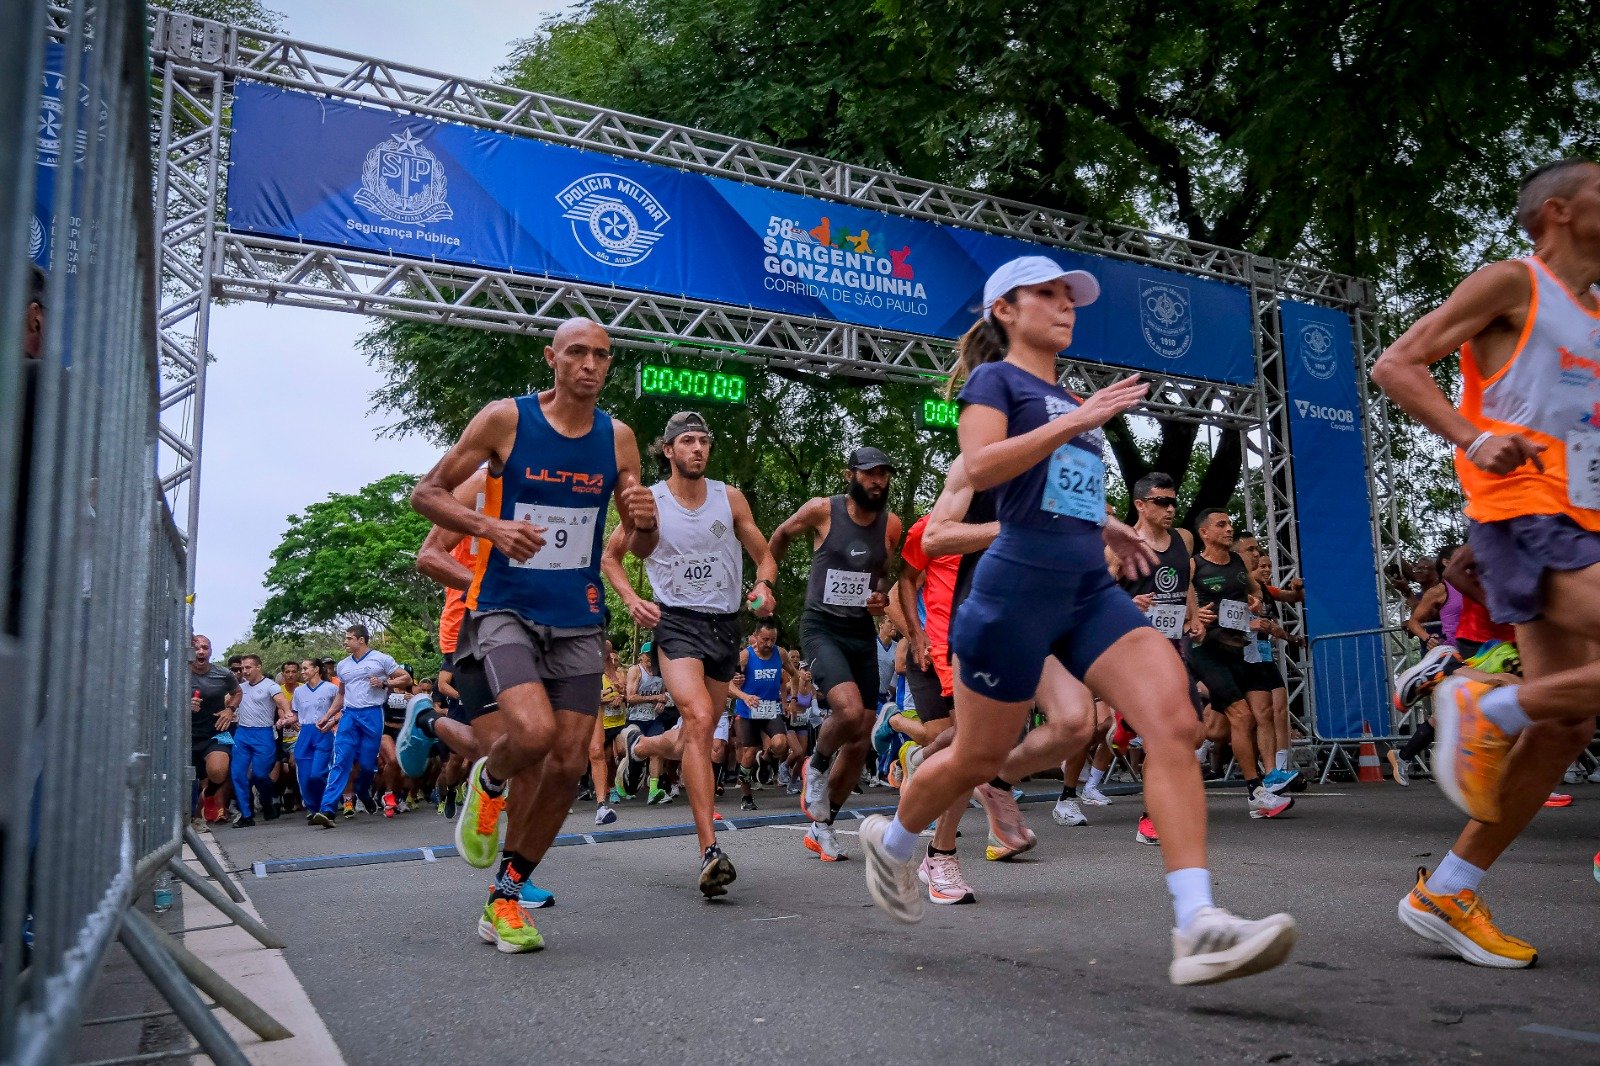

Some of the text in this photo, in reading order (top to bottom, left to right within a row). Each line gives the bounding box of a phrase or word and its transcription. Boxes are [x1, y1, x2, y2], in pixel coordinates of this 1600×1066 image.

[563, 177, 664, 222] POLÍCIA MILITAR
[346, 218, 461, 246] Segurança Pública
[763, 235, 892, 275] SARGENTO
[763, 256, 927, 300] GONZAGUINHA
[764, 277, 928, 316] CORRIDA DE SÃO PAULO
[1309, 404, 1354, 423] SICOOB
[525, 467, 604, 487] ULTRA
[554, 529, 568, 549] 9
[683, 565, 712, 580] 402
[831, 581, 864, 595] 2335
[1226, 609, 1244, 620] 607
